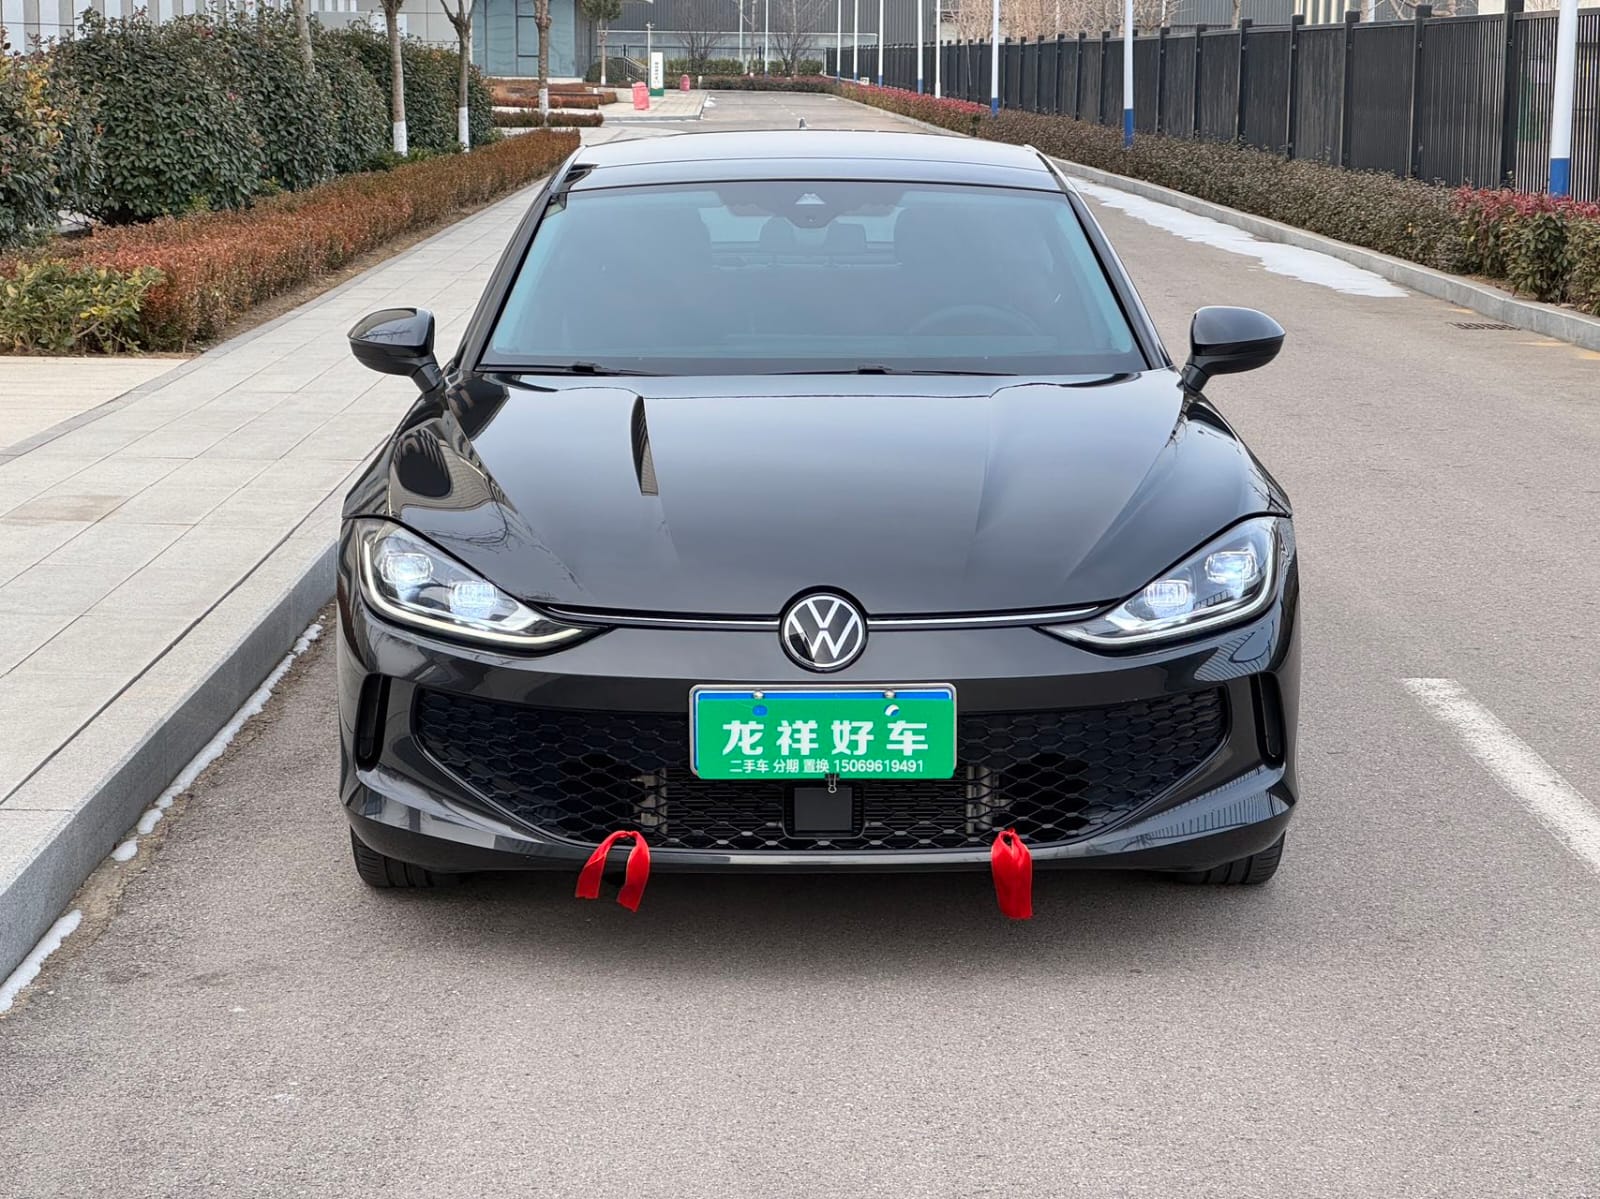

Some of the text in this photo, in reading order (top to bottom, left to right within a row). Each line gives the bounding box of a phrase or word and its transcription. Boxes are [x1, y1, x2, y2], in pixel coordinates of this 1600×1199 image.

[788, 597, 859, 662] VW
[721, 719, 929, 756] 龙祥好车
[729, 758, 924, 774] 二手车 分期 置换 15069619491
